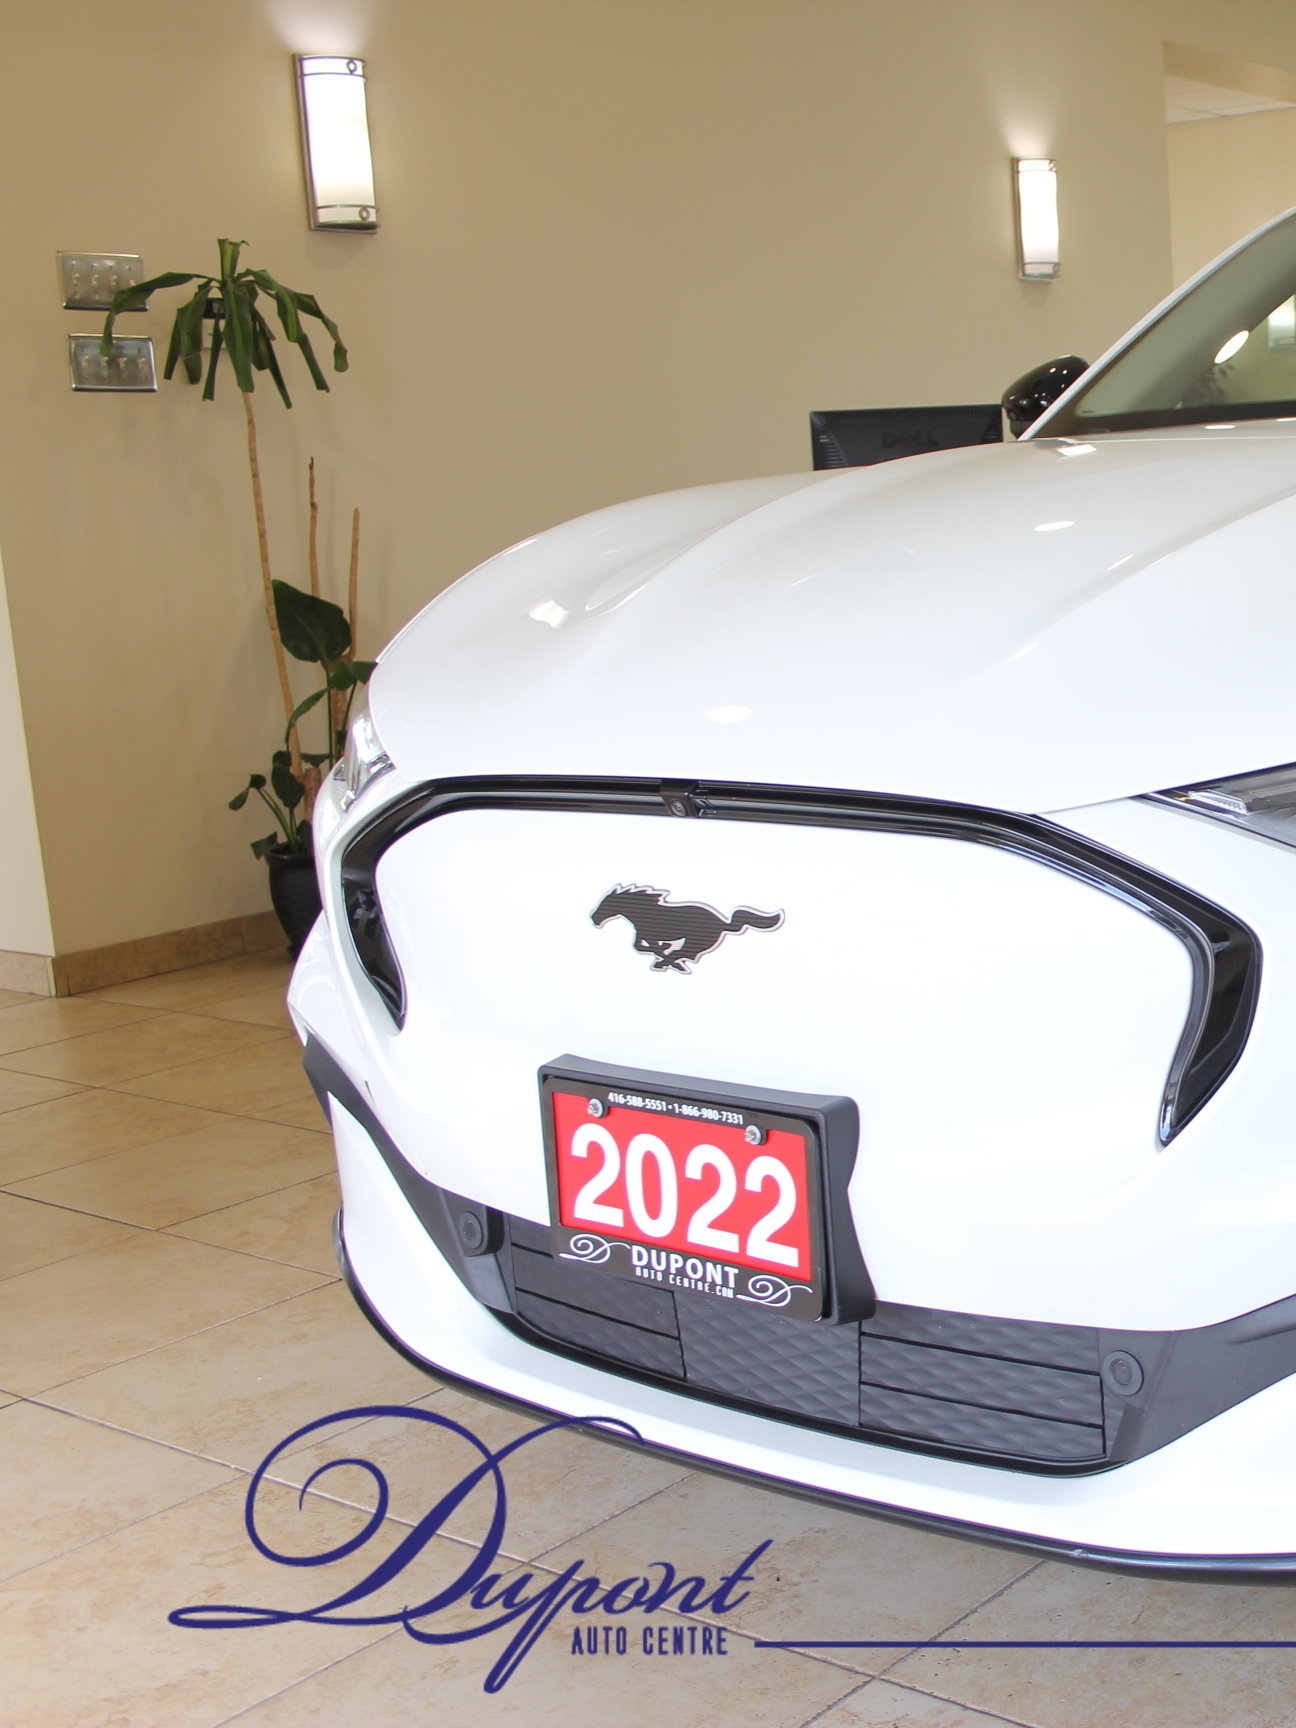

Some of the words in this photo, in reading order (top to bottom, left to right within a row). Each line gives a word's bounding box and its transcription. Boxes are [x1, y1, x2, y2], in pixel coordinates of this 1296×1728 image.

[881, 428, 939, 449] DELL
[607, 1091, 667, 1112] 416-588-5551
[673, 1103, 744, 1125] 1-866-980-7331
[571, 1123, 799, 1268] 2022
[631, 1245, 739, 1288] DUPONT
[635, 1266, 663, 1282] AUTO
